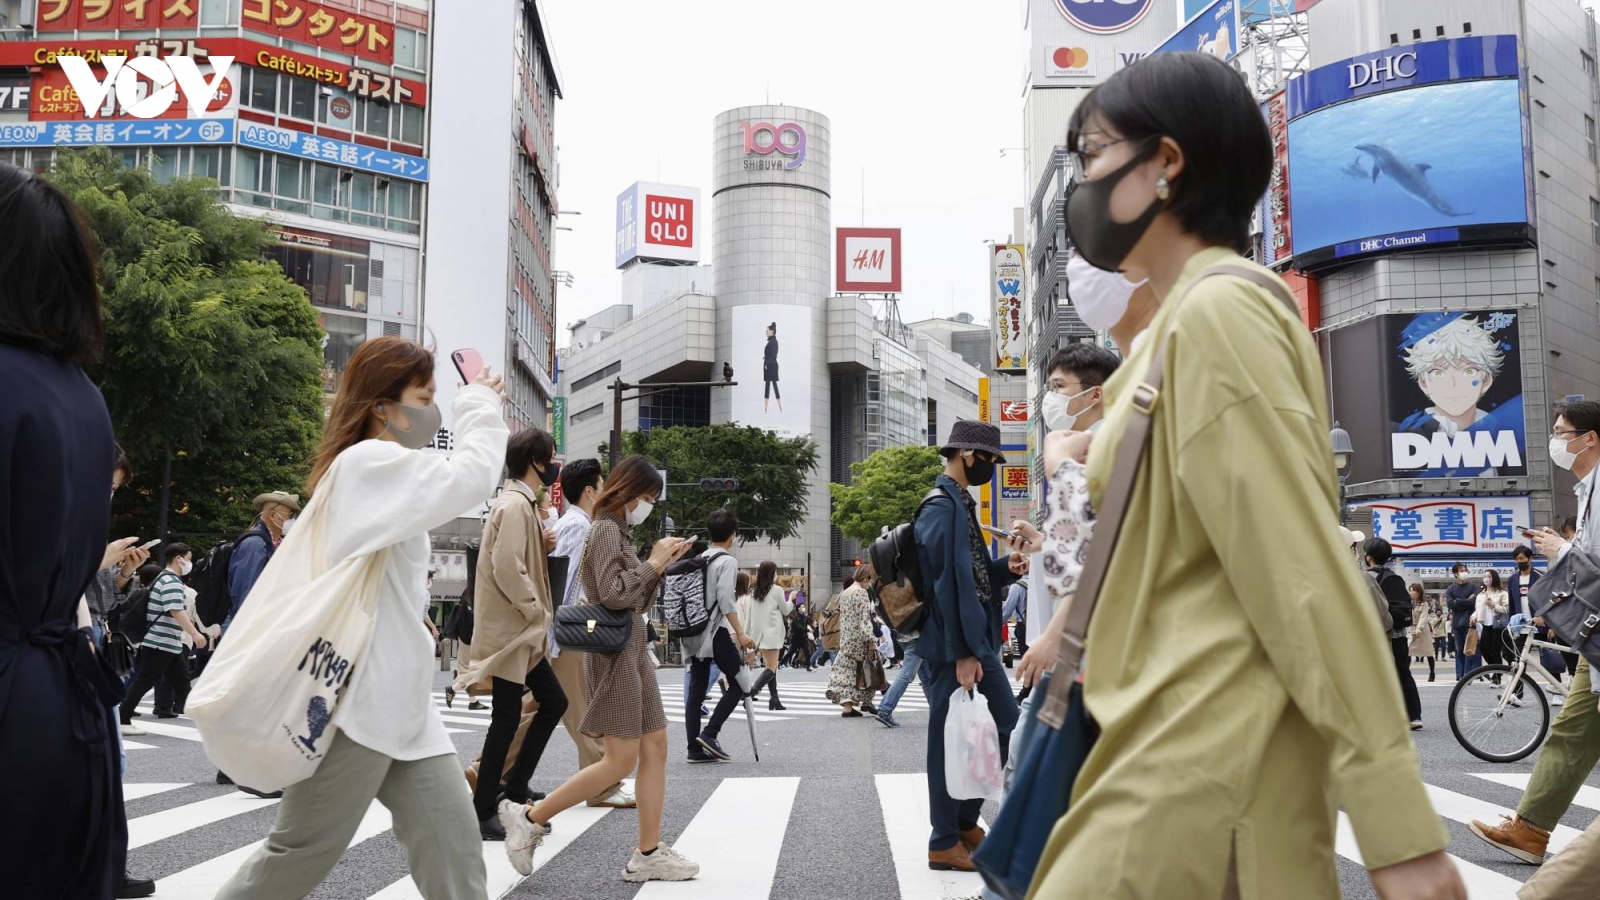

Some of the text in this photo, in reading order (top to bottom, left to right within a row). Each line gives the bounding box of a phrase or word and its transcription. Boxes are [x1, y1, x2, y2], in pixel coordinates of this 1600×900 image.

[243, 0, 391, 52] コンタクト
[1117, 52, 1147, 67] VI
[1347, 51, 1418, 89] DHC
[257, 50, 413, 104] Caféレストラン ガスト
[39, 102, 79, 113] レストラン
[53, 123, 192, 143] 英会話イーオン
[201, 124, 222, 138] 6F
[246, 126, 425, 175] AEON 英会話イーオン
[738, 121, 807, 170] 109
[743, 159, 783, 170] SHIBUYA
[651, 200, 685, 221] UNI
[650, 221, 688, 242] QLO
[1360, 233, 1427, 251] DHC Channel
[852, 249, 886, 270] H&M
[1392, 429, 1522, 469] DMM
